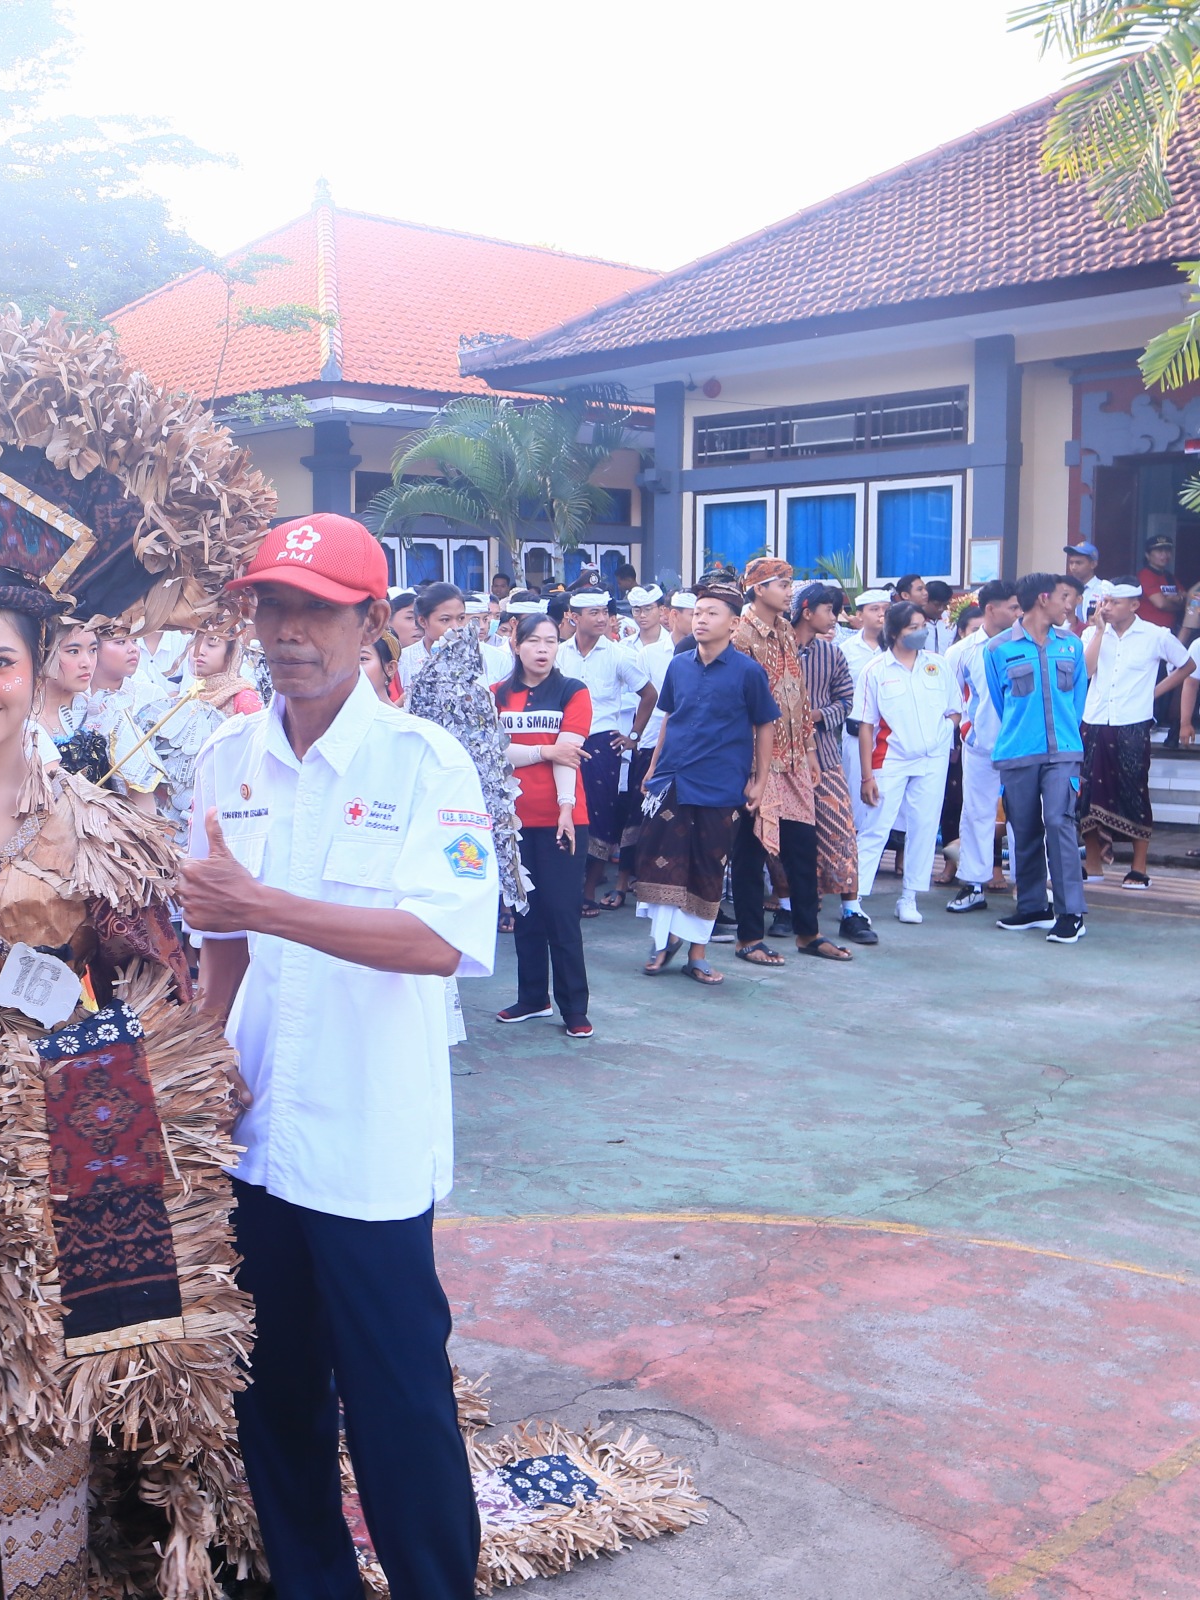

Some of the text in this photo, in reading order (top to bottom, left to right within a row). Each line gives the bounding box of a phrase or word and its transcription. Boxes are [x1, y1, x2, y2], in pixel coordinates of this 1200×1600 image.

[276, 551, 314, 564] PMI
[517, 716, 523, 729] 3
[373, 801, 397, 812] Palang
[369, 811, 392, 821] Merah
[365, 820, 400, 832] Indonesia
[11, 955, 62, 1007] 16
